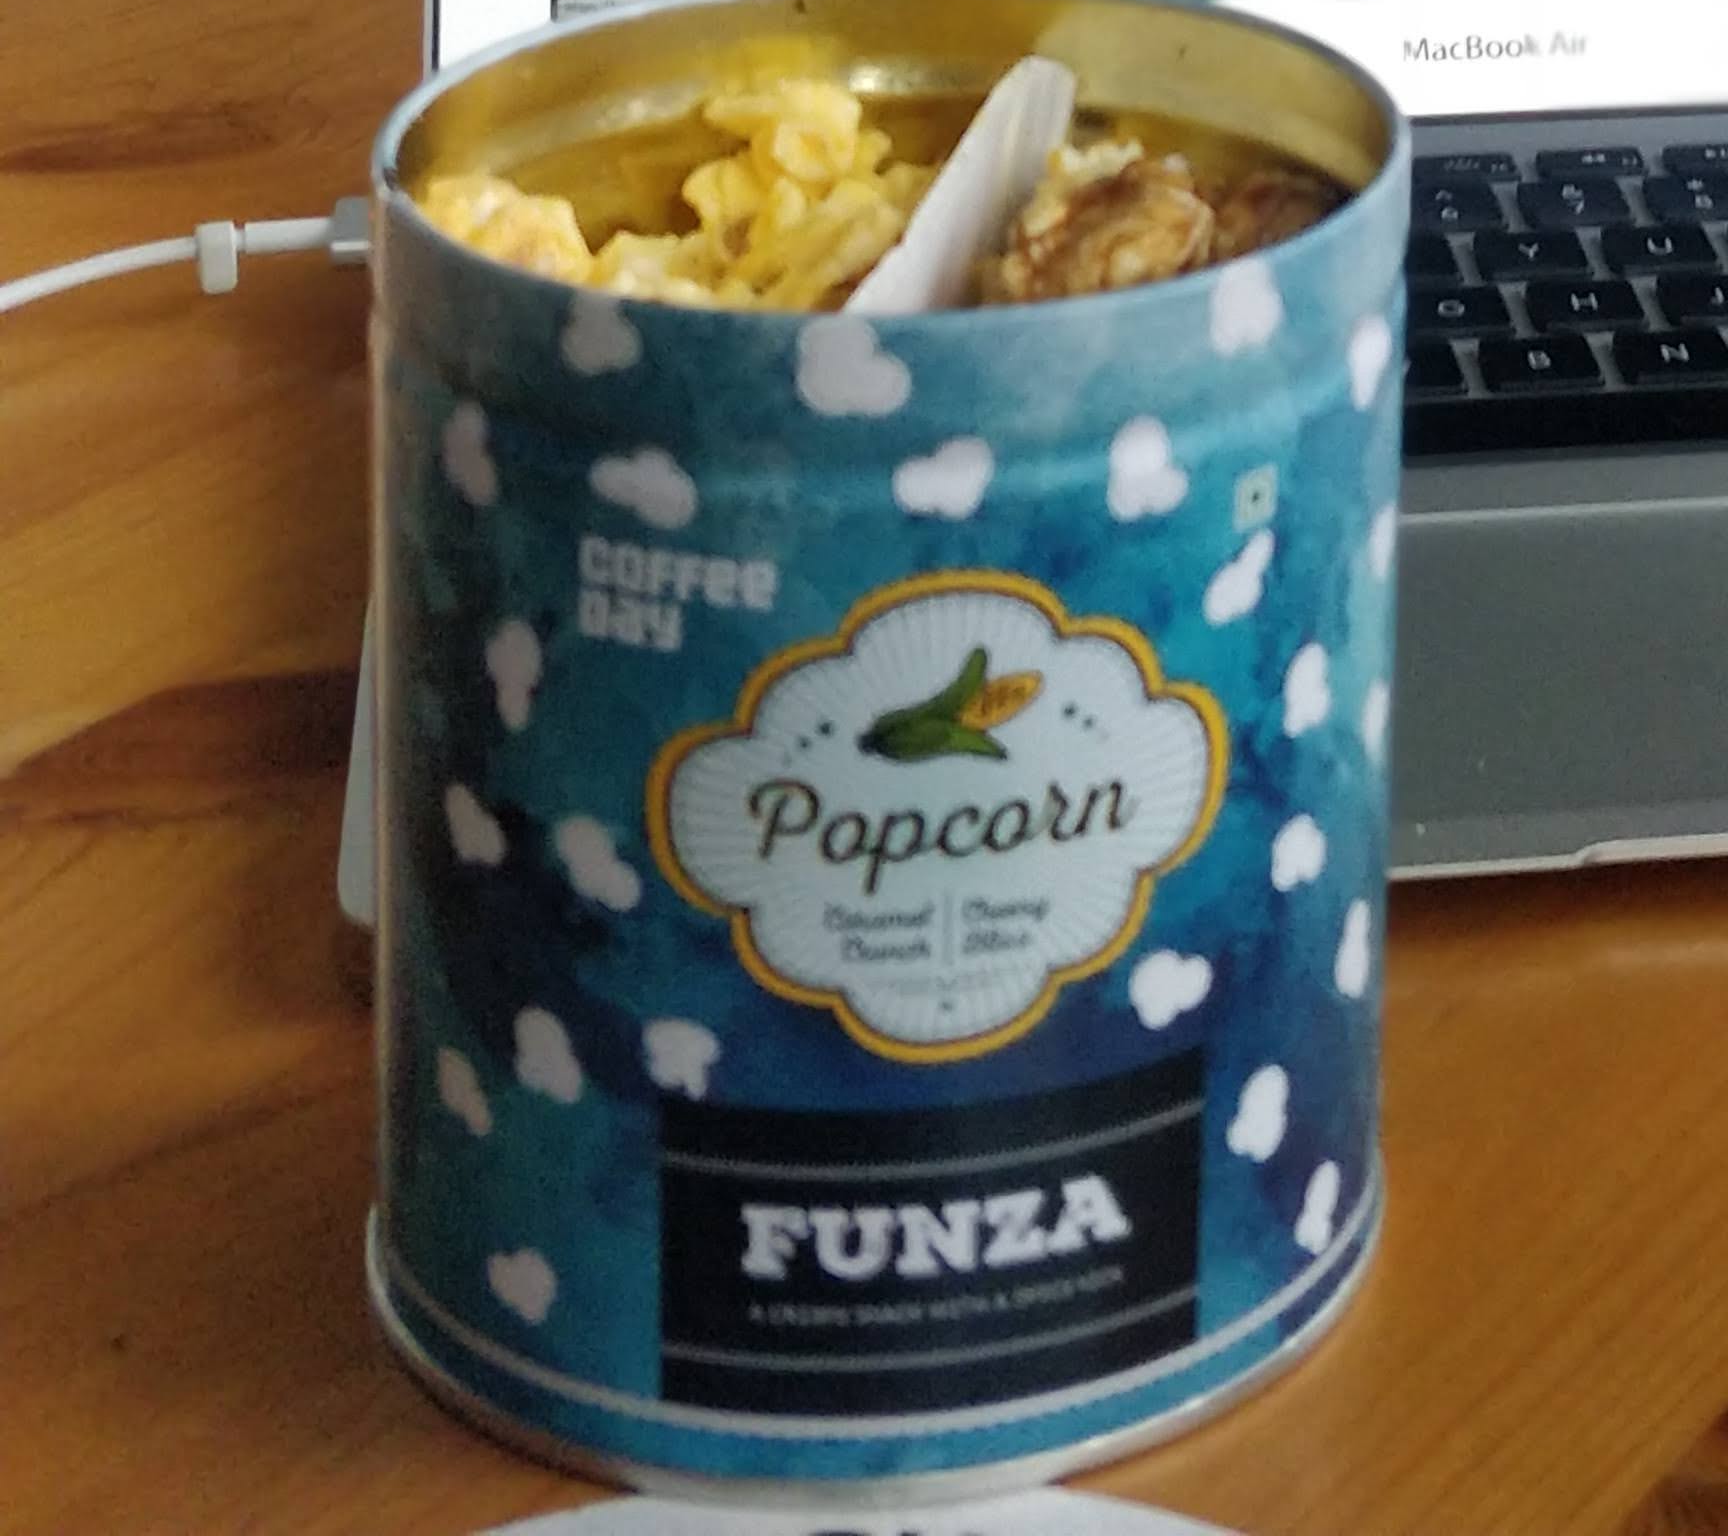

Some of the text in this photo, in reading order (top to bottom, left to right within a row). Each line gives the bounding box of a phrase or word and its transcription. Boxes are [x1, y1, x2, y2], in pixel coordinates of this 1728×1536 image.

[1403, 31, 1587, 62] MacBook Air
[1518, 241, 1541, 259] Y
[1646, 236, 1673, 255] U
[1570, 291, 1599, 313] H
[1710, 285, 1725, 306] J
[1660, 342, 1689, 364] N
[748, 773, 1131, 896] Popcorn
[740, 1172, 1133, 1282] FUNZA
